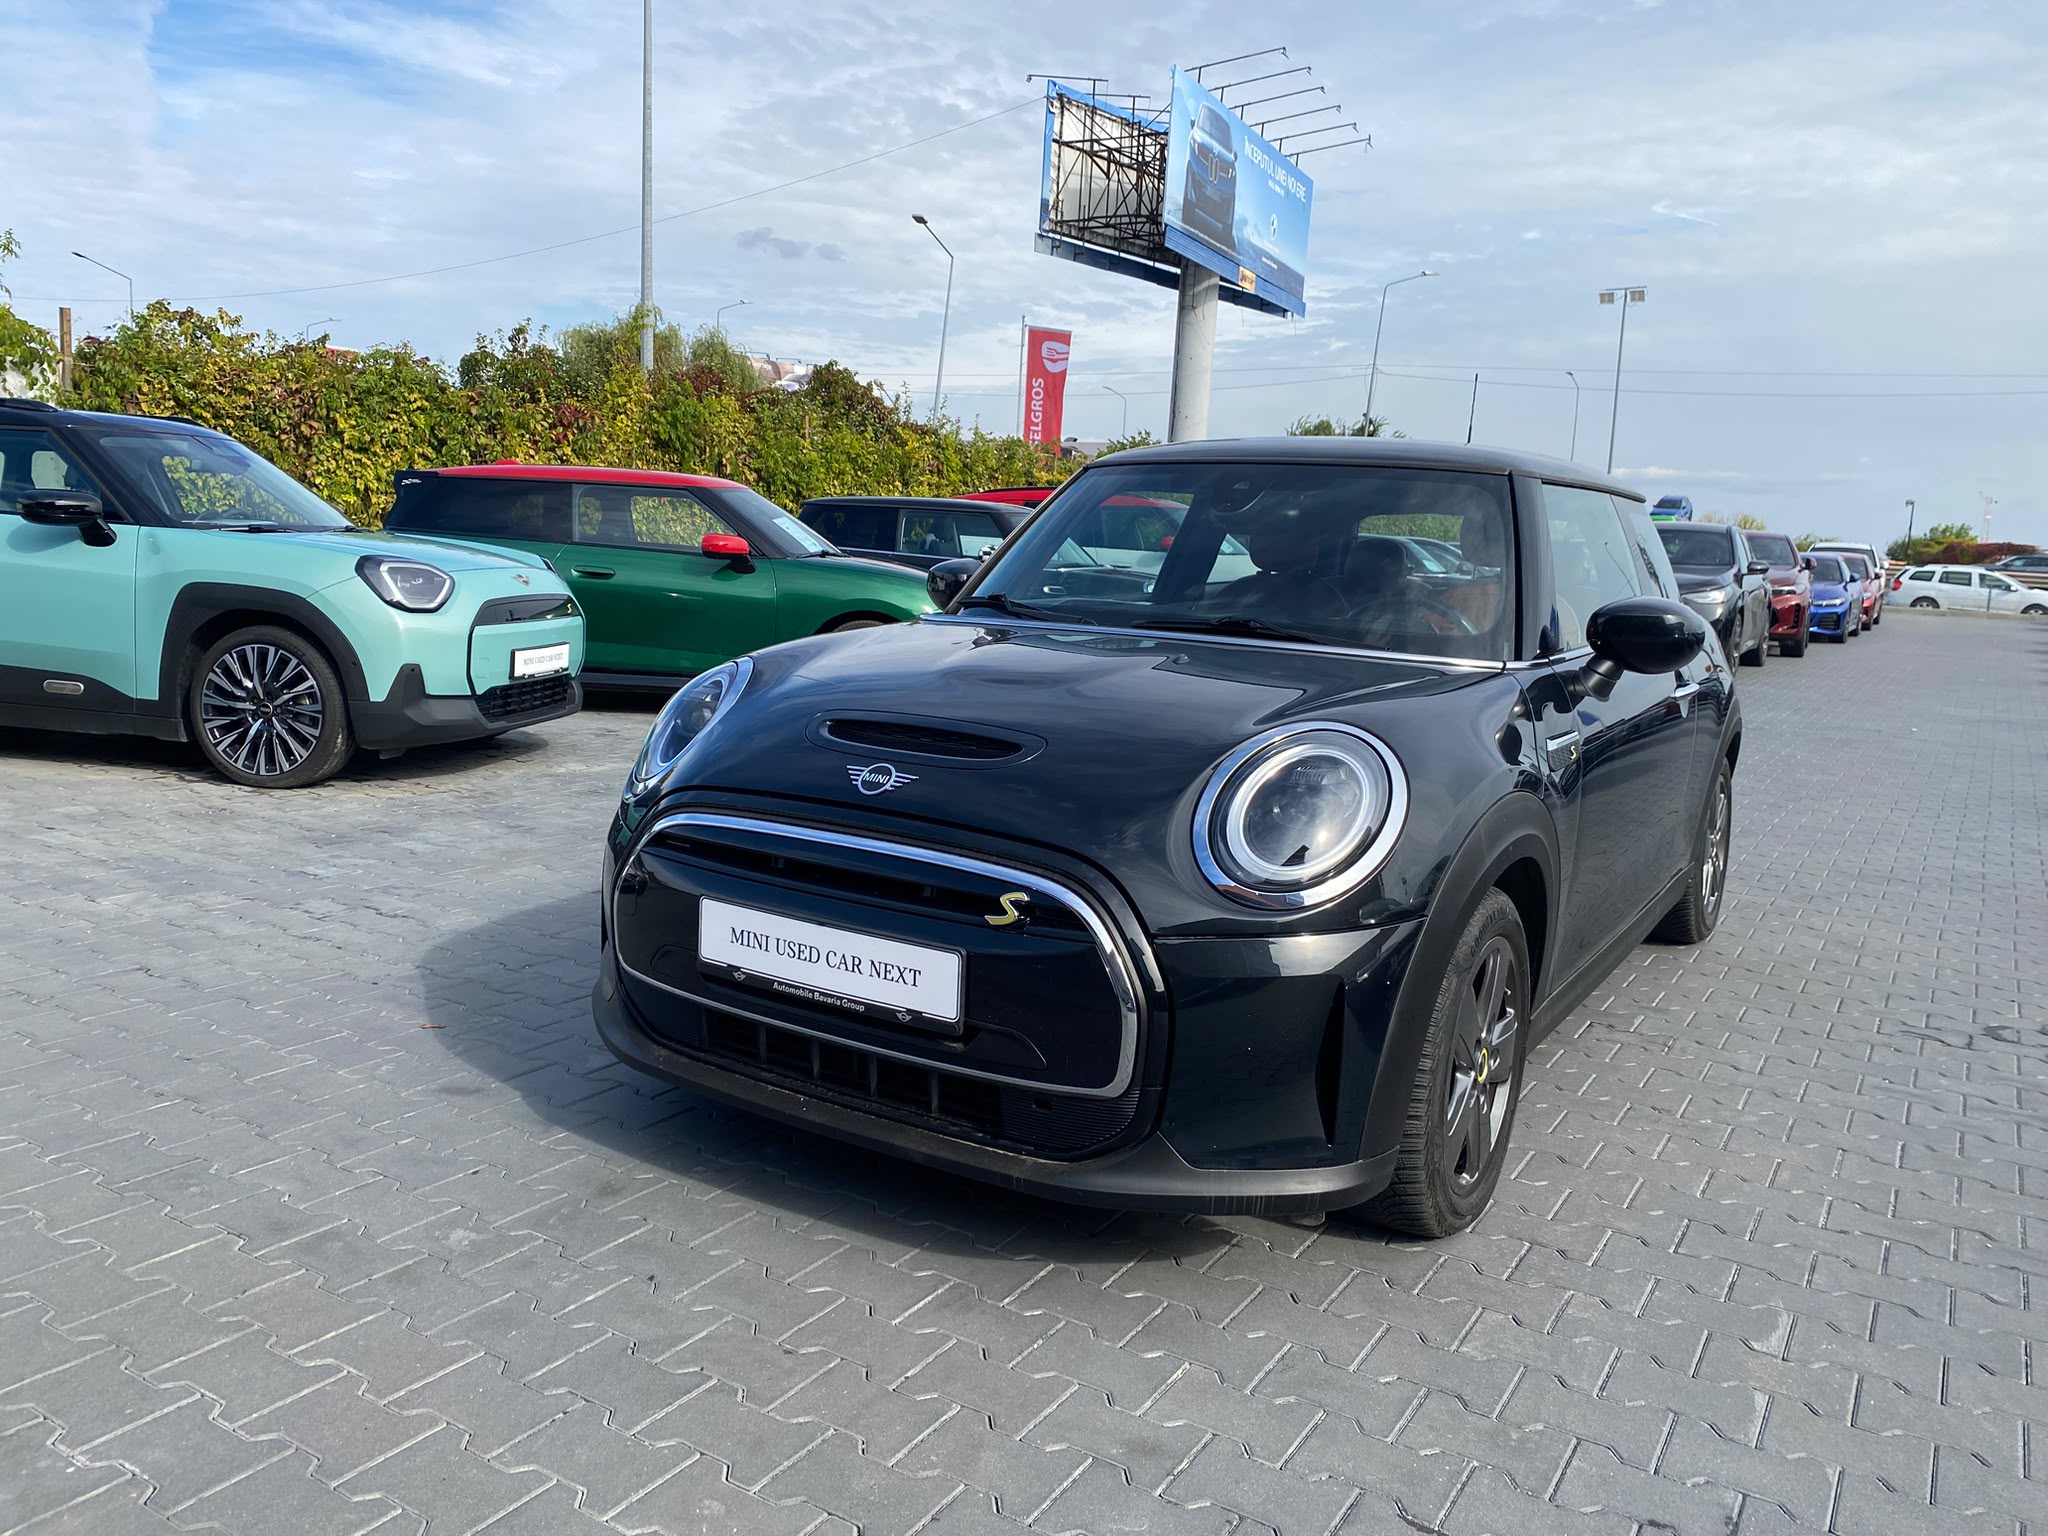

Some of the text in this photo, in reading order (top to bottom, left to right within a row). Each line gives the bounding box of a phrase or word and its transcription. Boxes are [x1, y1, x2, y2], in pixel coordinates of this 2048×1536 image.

[862, 772, 890, 784] MINI
[984, 891, 1029, 925] S
[730, 926, 922, 988] MINI USED CAR NEXT
[772, 981, 865, 1013] Automobile Bavaria Group
